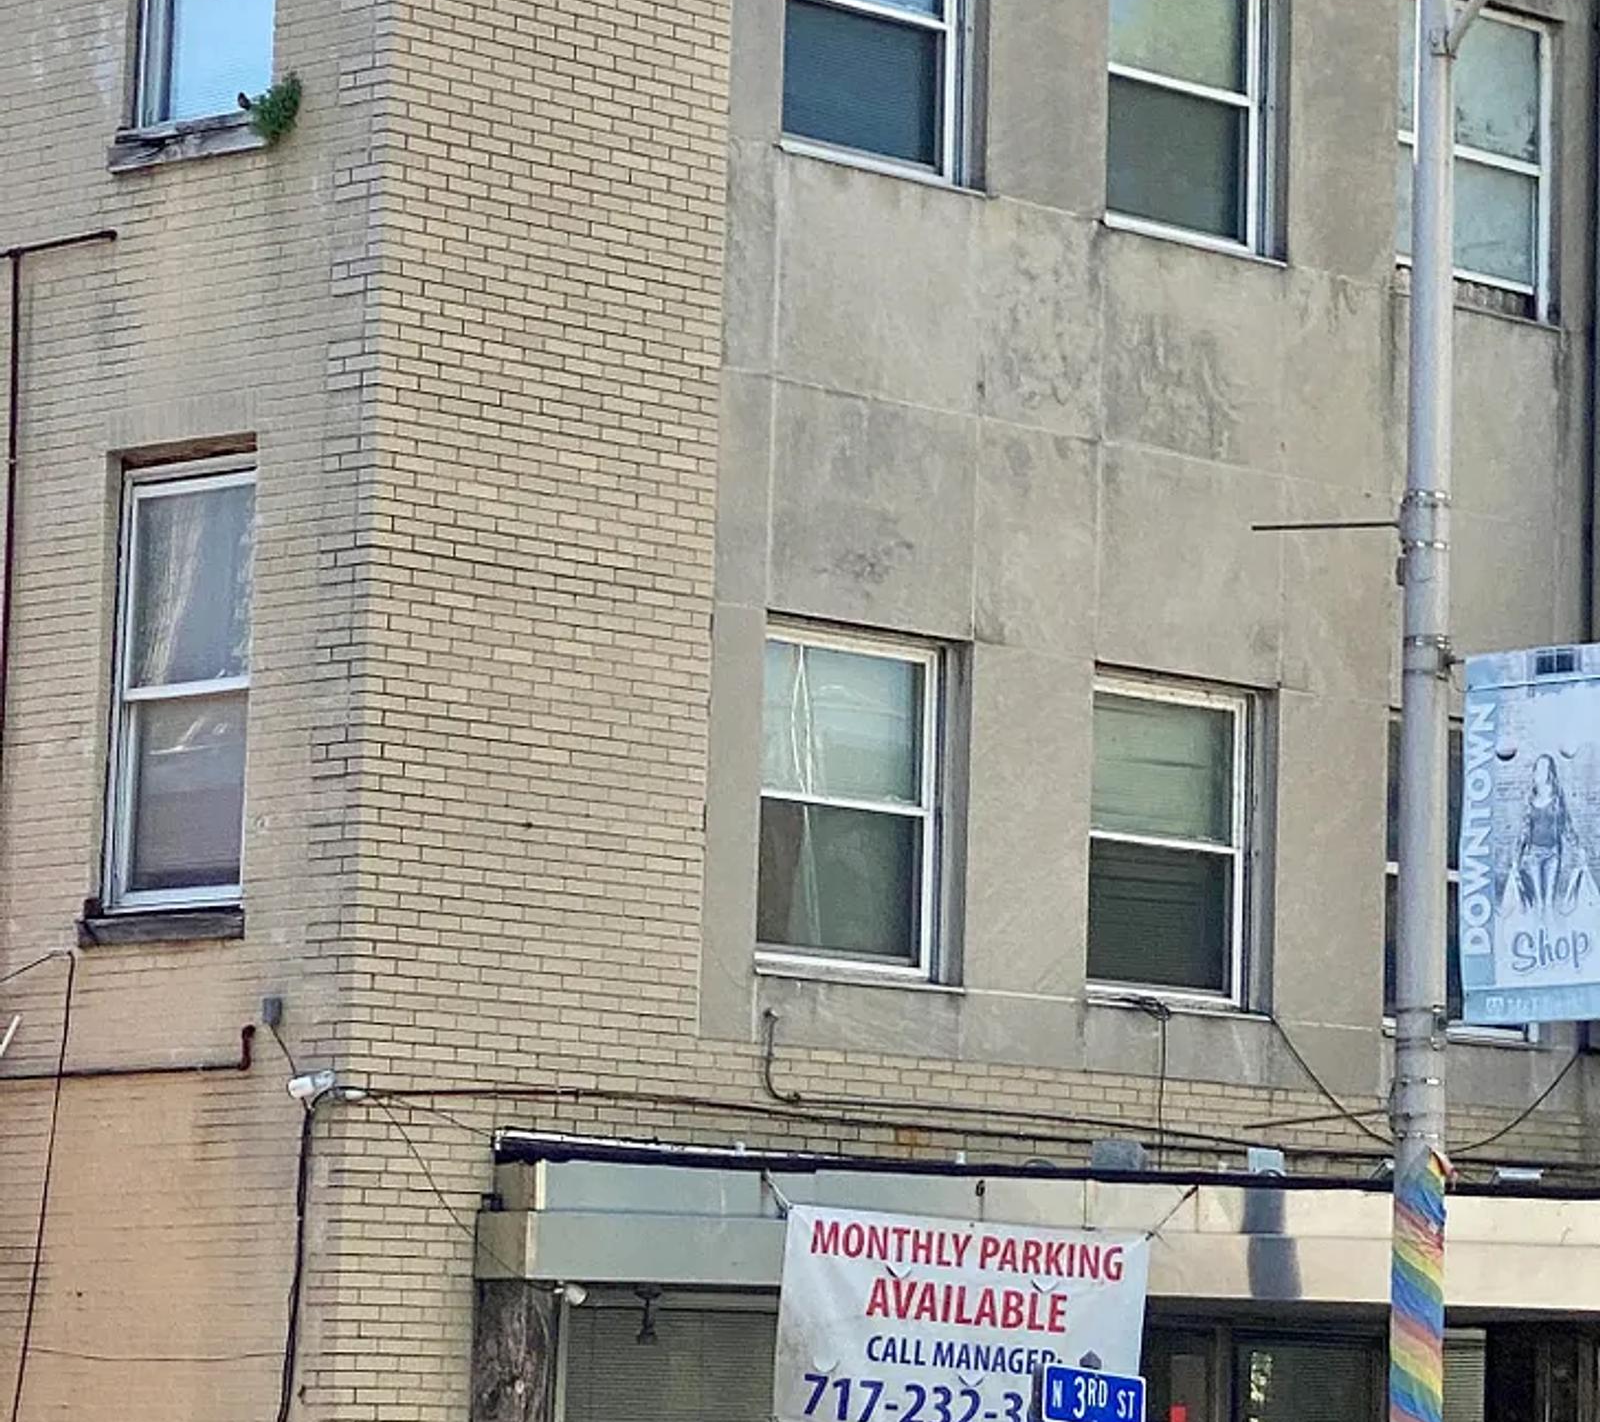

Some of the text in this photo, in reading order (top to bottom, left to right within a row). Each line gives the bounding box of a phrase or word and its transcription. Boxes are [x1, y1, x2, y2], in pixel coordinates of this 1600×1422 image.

[1464, 703, 1496, 956] DOWNTOWN
[1511, 929, 1590, 972] Shop
[810, 1218, 1124, 1282] MONTHLY PARKING
[865, 1277, 1068, 1333] AVAILABLE
[866, 1335, 927, 1367] CALL
[1051, 1375, 1137, 1420] N 3RD ST
